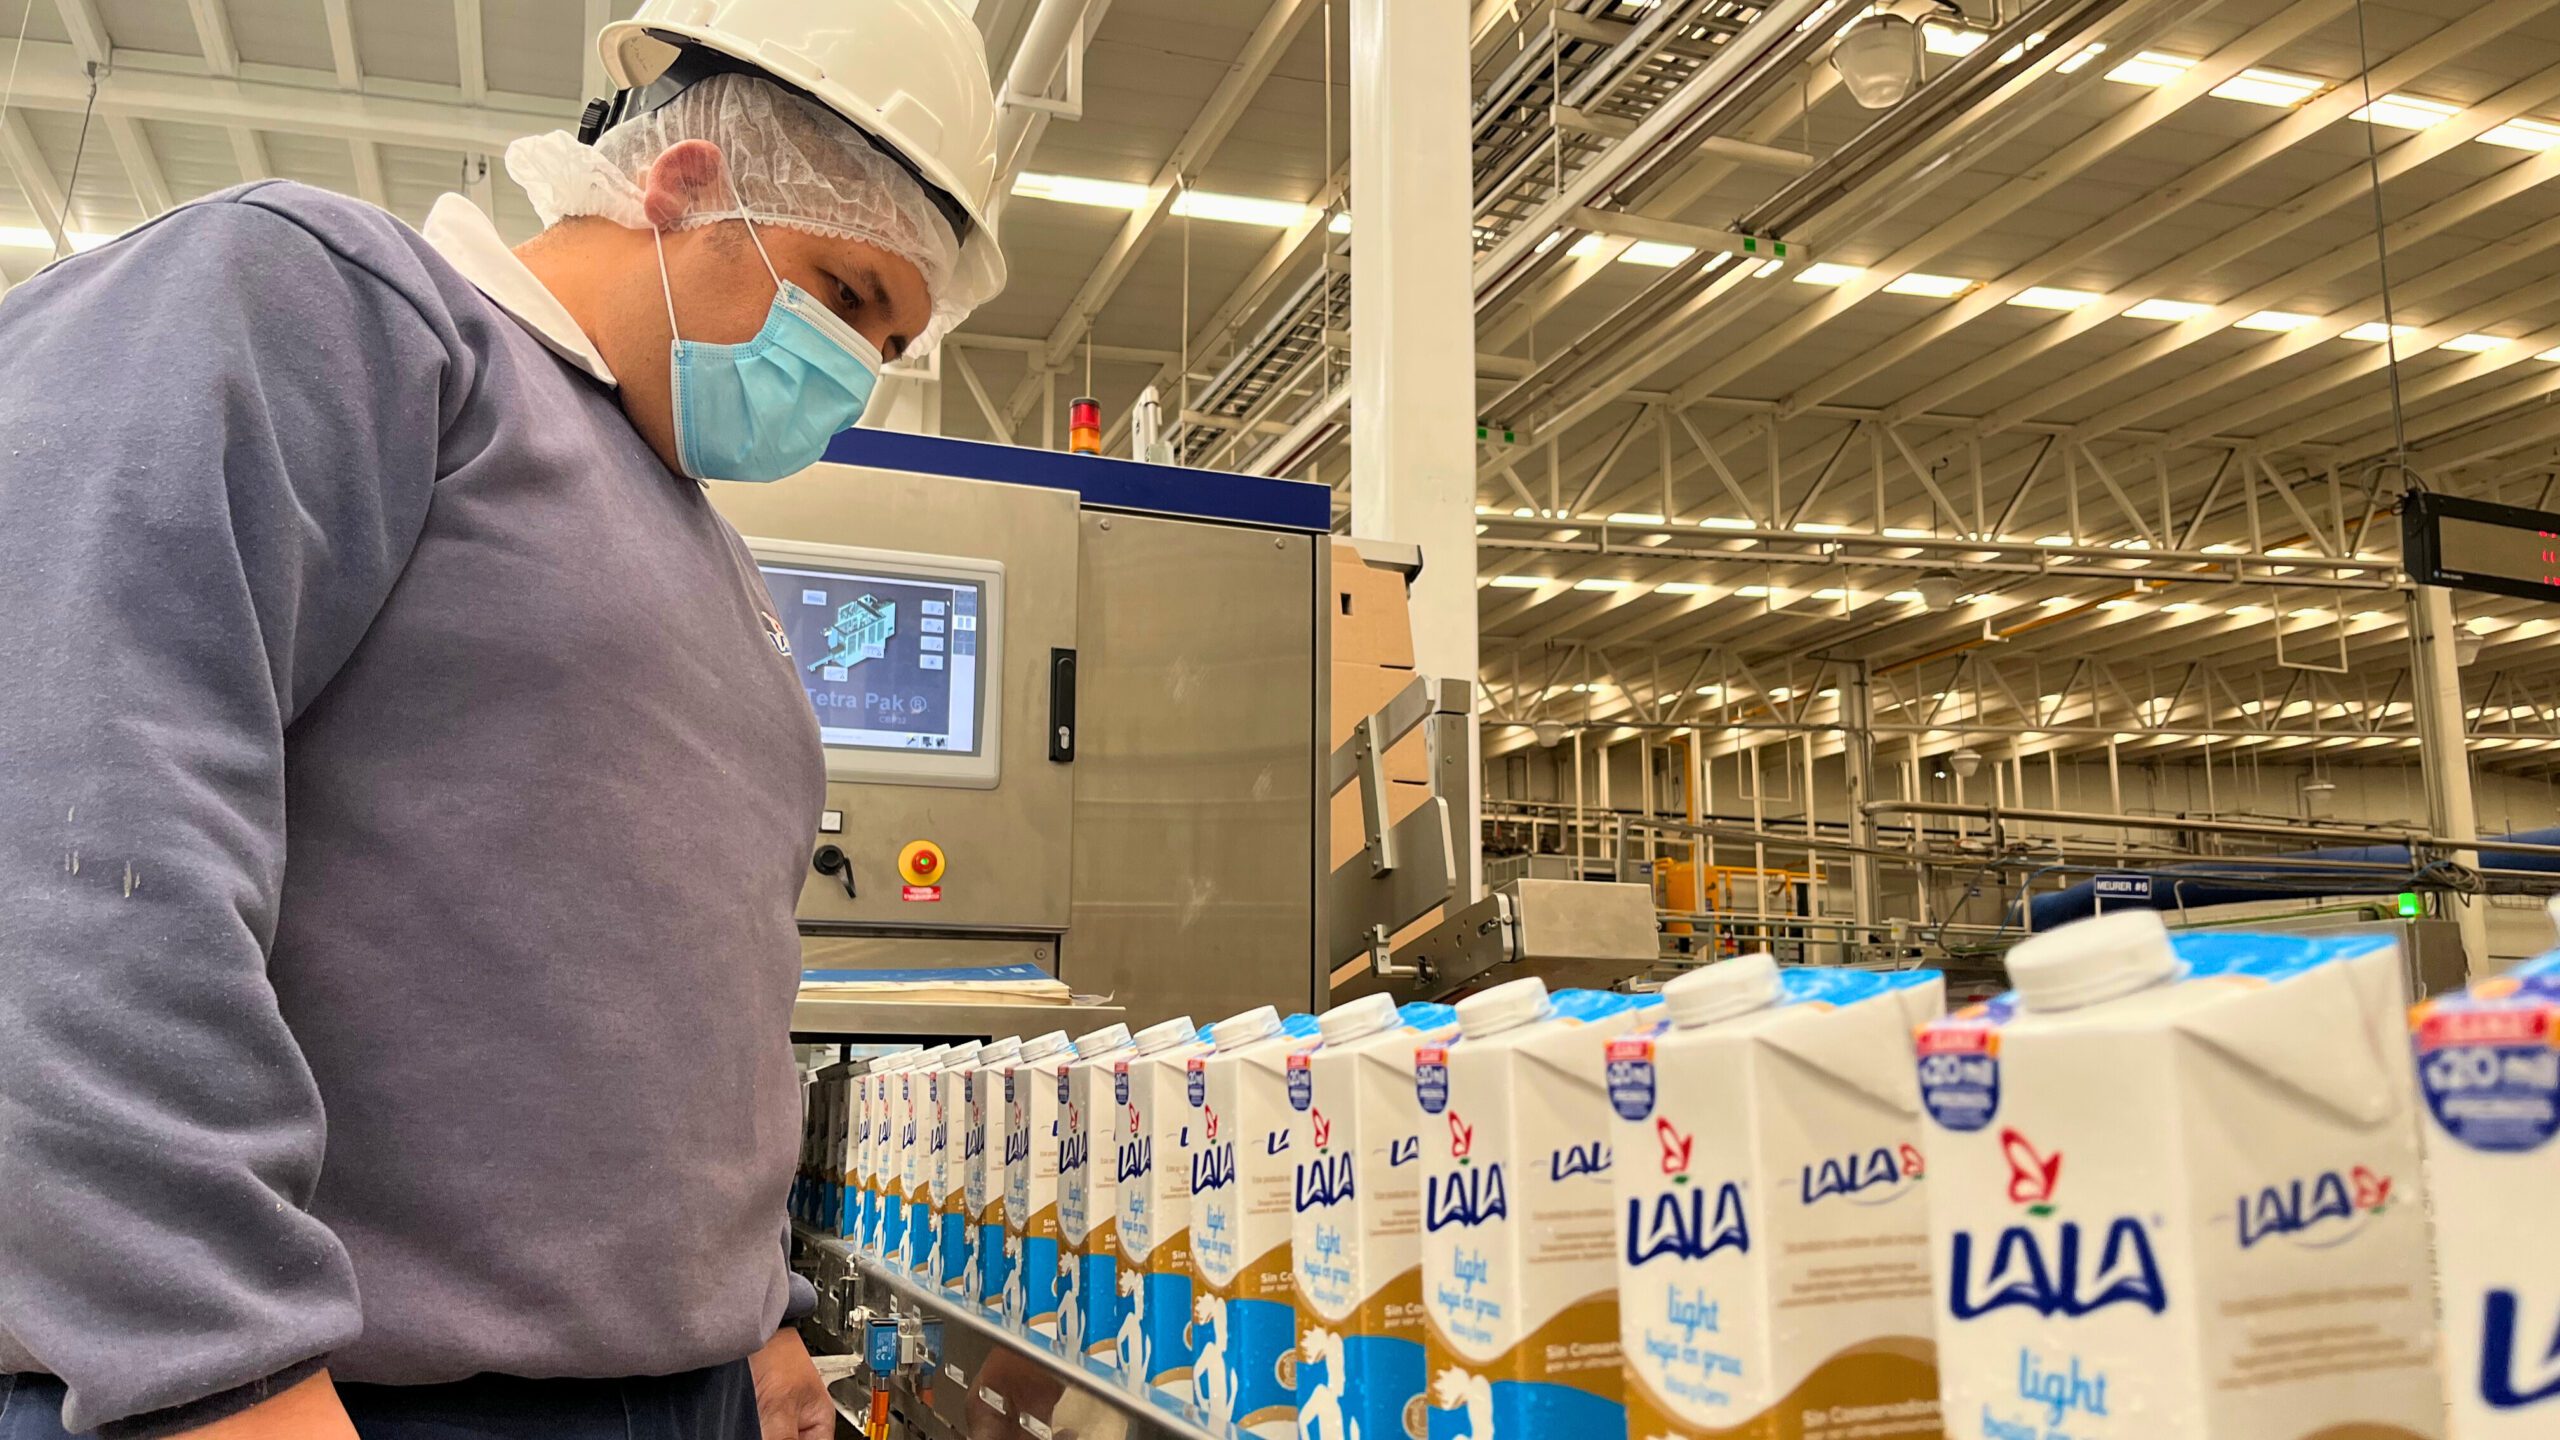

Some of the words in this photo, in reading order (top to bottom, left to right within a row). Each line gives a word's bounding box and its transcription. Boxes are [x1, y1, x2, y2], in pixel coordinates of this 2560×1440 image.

[805, 688, 857, 709] Tetra
[865, 693, 904, 712] Pak
[2096, 881, 2132, 892] MEURER
[965, 1124, 984, 1160] LALA
[1006, 1127, 1028, 1165] LALA
[1059, 1131, 1088, 1174] LALA
[1118, 1135, 1151, 1183] LALA
[1192, 1142, 1235, 1195] LALA
[1296, 1152, 1354, 1212] LALA
[1802, 1148, 1898, 1203] LALA
[1427, 1163, 1506, 1232] LALA
[2239, 1172, 2351, 1247] LALA
[1207, 1203, 1225, 1239] light
[1316, 1223, 1341, 1263] light
[1628, 1184, 1749, 1266] LALA
[1172, 1251, 1187, 1260] Sin
[1454, 1243, 1487, 1294] light
[1951, 1218, 2166, 1320] LALA
[1261, 1273, 1277, 1284] Sin
[1385, 1305, 1403, 1317] Sin
[1668, 1283, 1719, 1344] light
[1546, 1345, 1567, 1360] Sin
[2020, 1346, 2107, 1427] light
